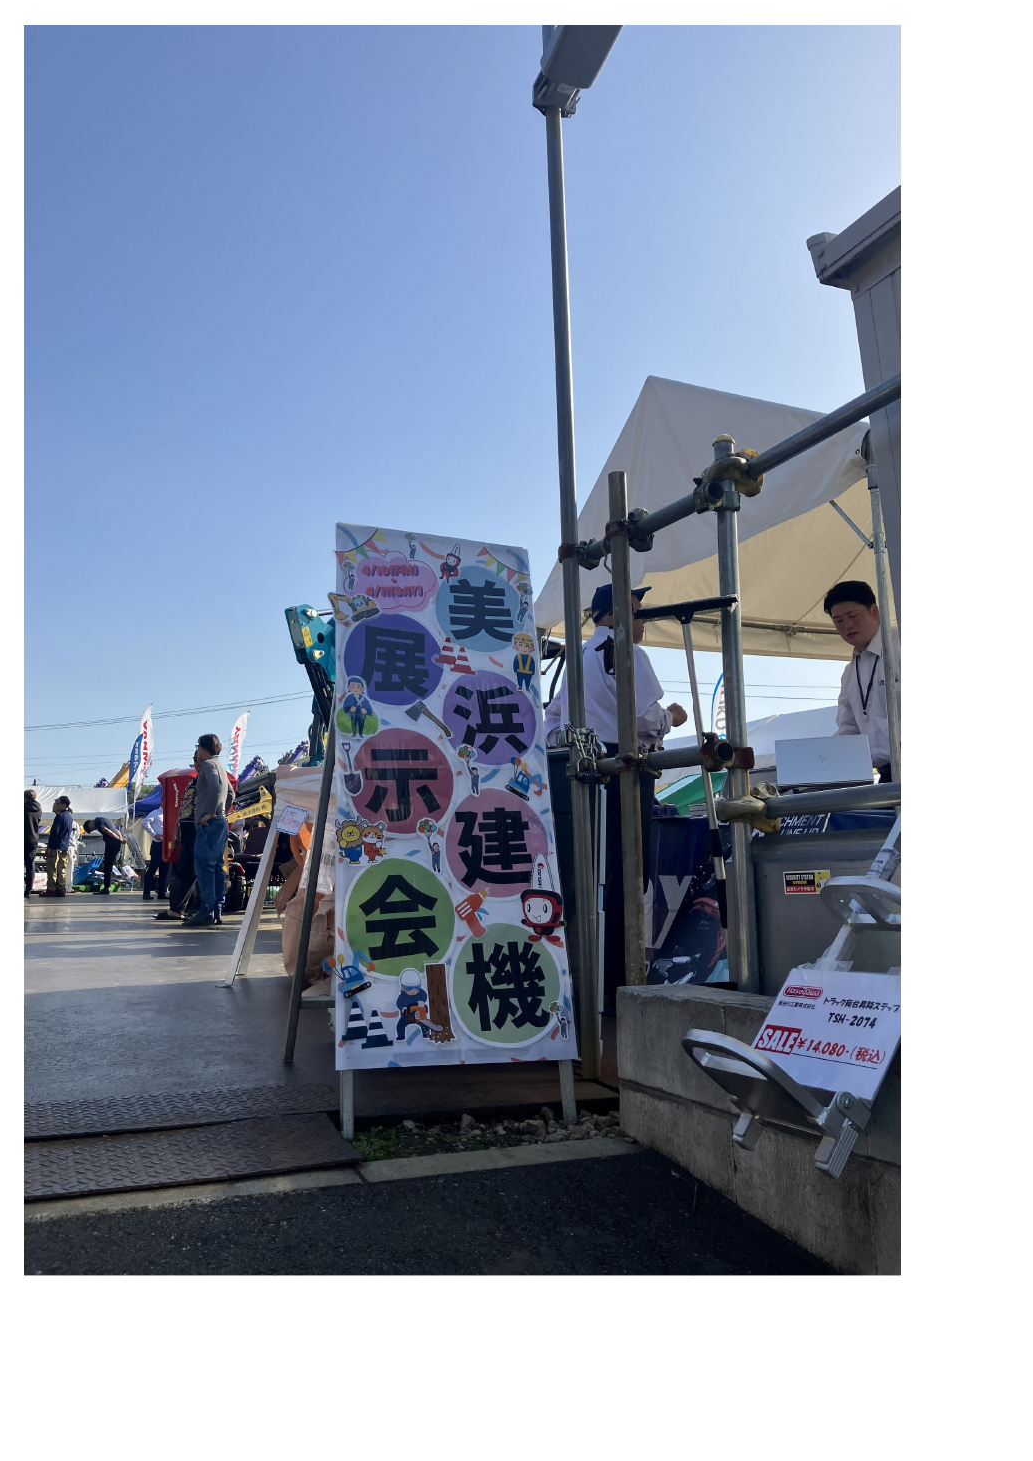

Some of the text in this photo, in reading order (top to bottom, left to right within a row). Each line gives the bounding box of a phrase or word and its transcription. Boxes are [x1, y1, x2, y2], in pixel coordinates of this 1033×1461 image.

[362, 564, 419, 576] 4/10(FRI)
[365, 585, 423, 598] 4/11(SAT)
[780, 813, 825, 827] CHMENT
[786, 987, 821, 997] Hasegawa
[823, 997, 901, 1012] トラック荷台昇降ステップ
[827, 1012, 877, 1028] TSH-2074
[757, 1027, 801, 1052] SALE
